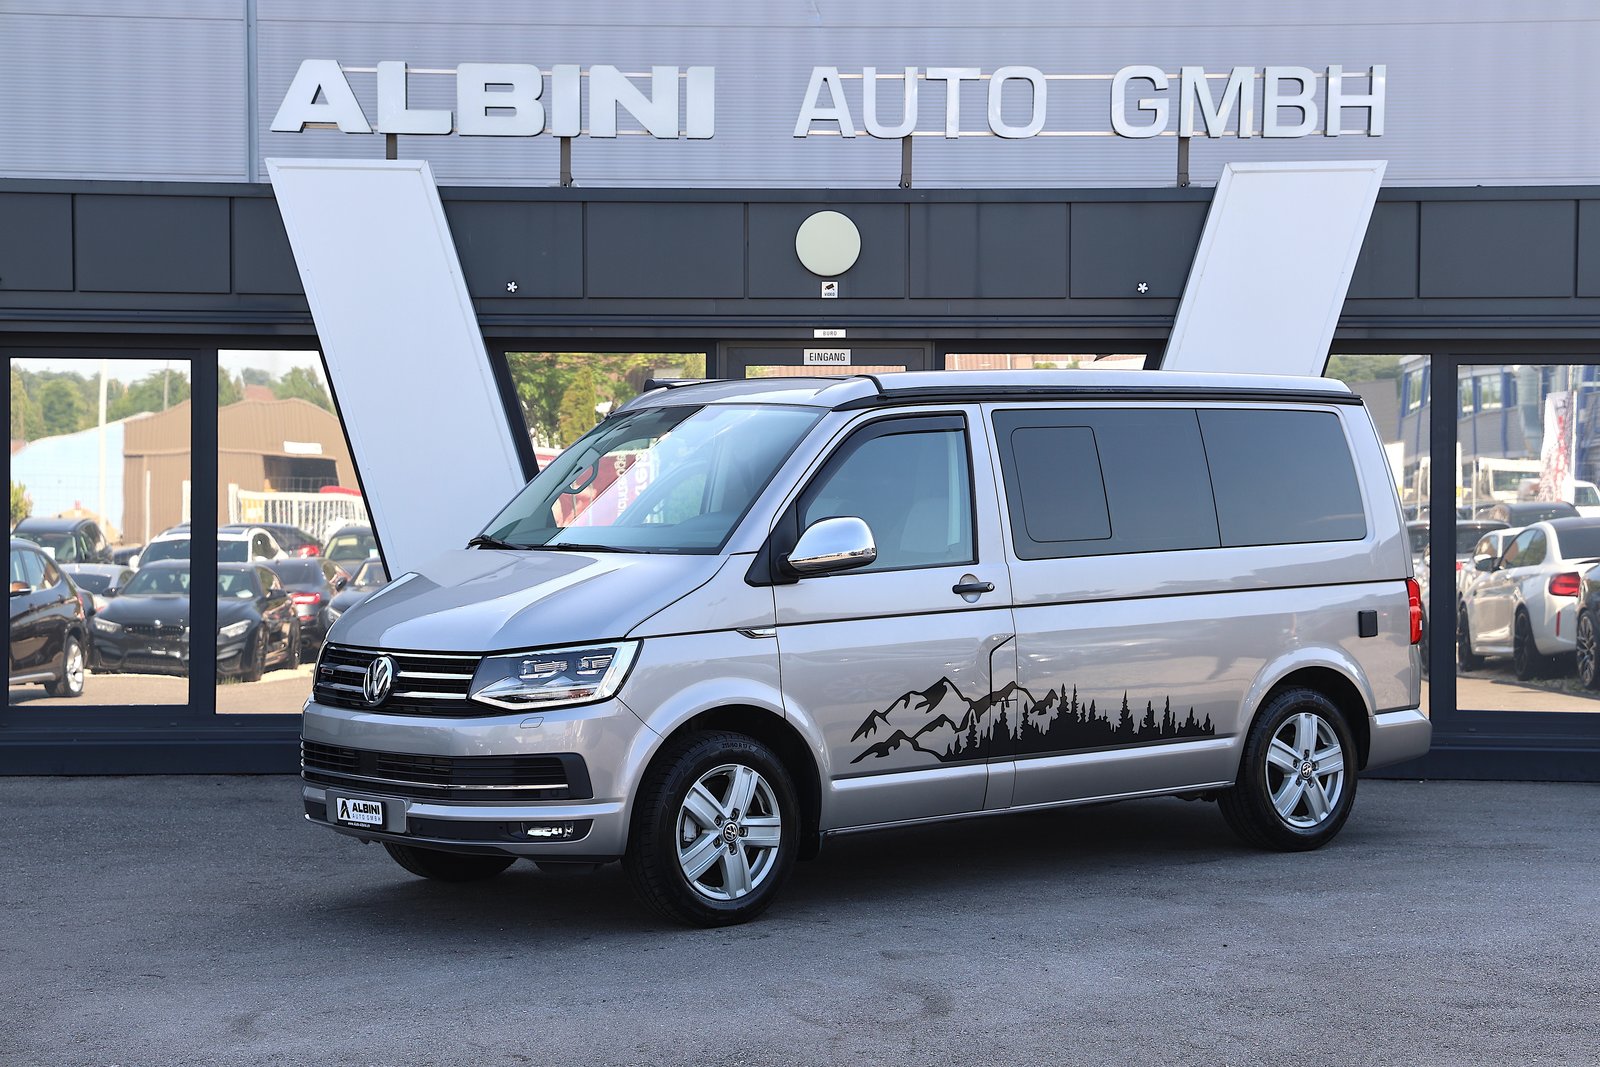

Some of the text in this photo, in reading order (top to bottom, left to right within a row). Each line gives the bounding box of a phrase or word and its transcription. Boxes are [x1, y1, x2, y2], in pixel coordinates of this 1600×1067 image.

[269, 59, 1387, 139] ALBINI AUTO GMBH
[809, 352, 846, 362] EINGANG
[352, 802, 380, 815] ALBINI
